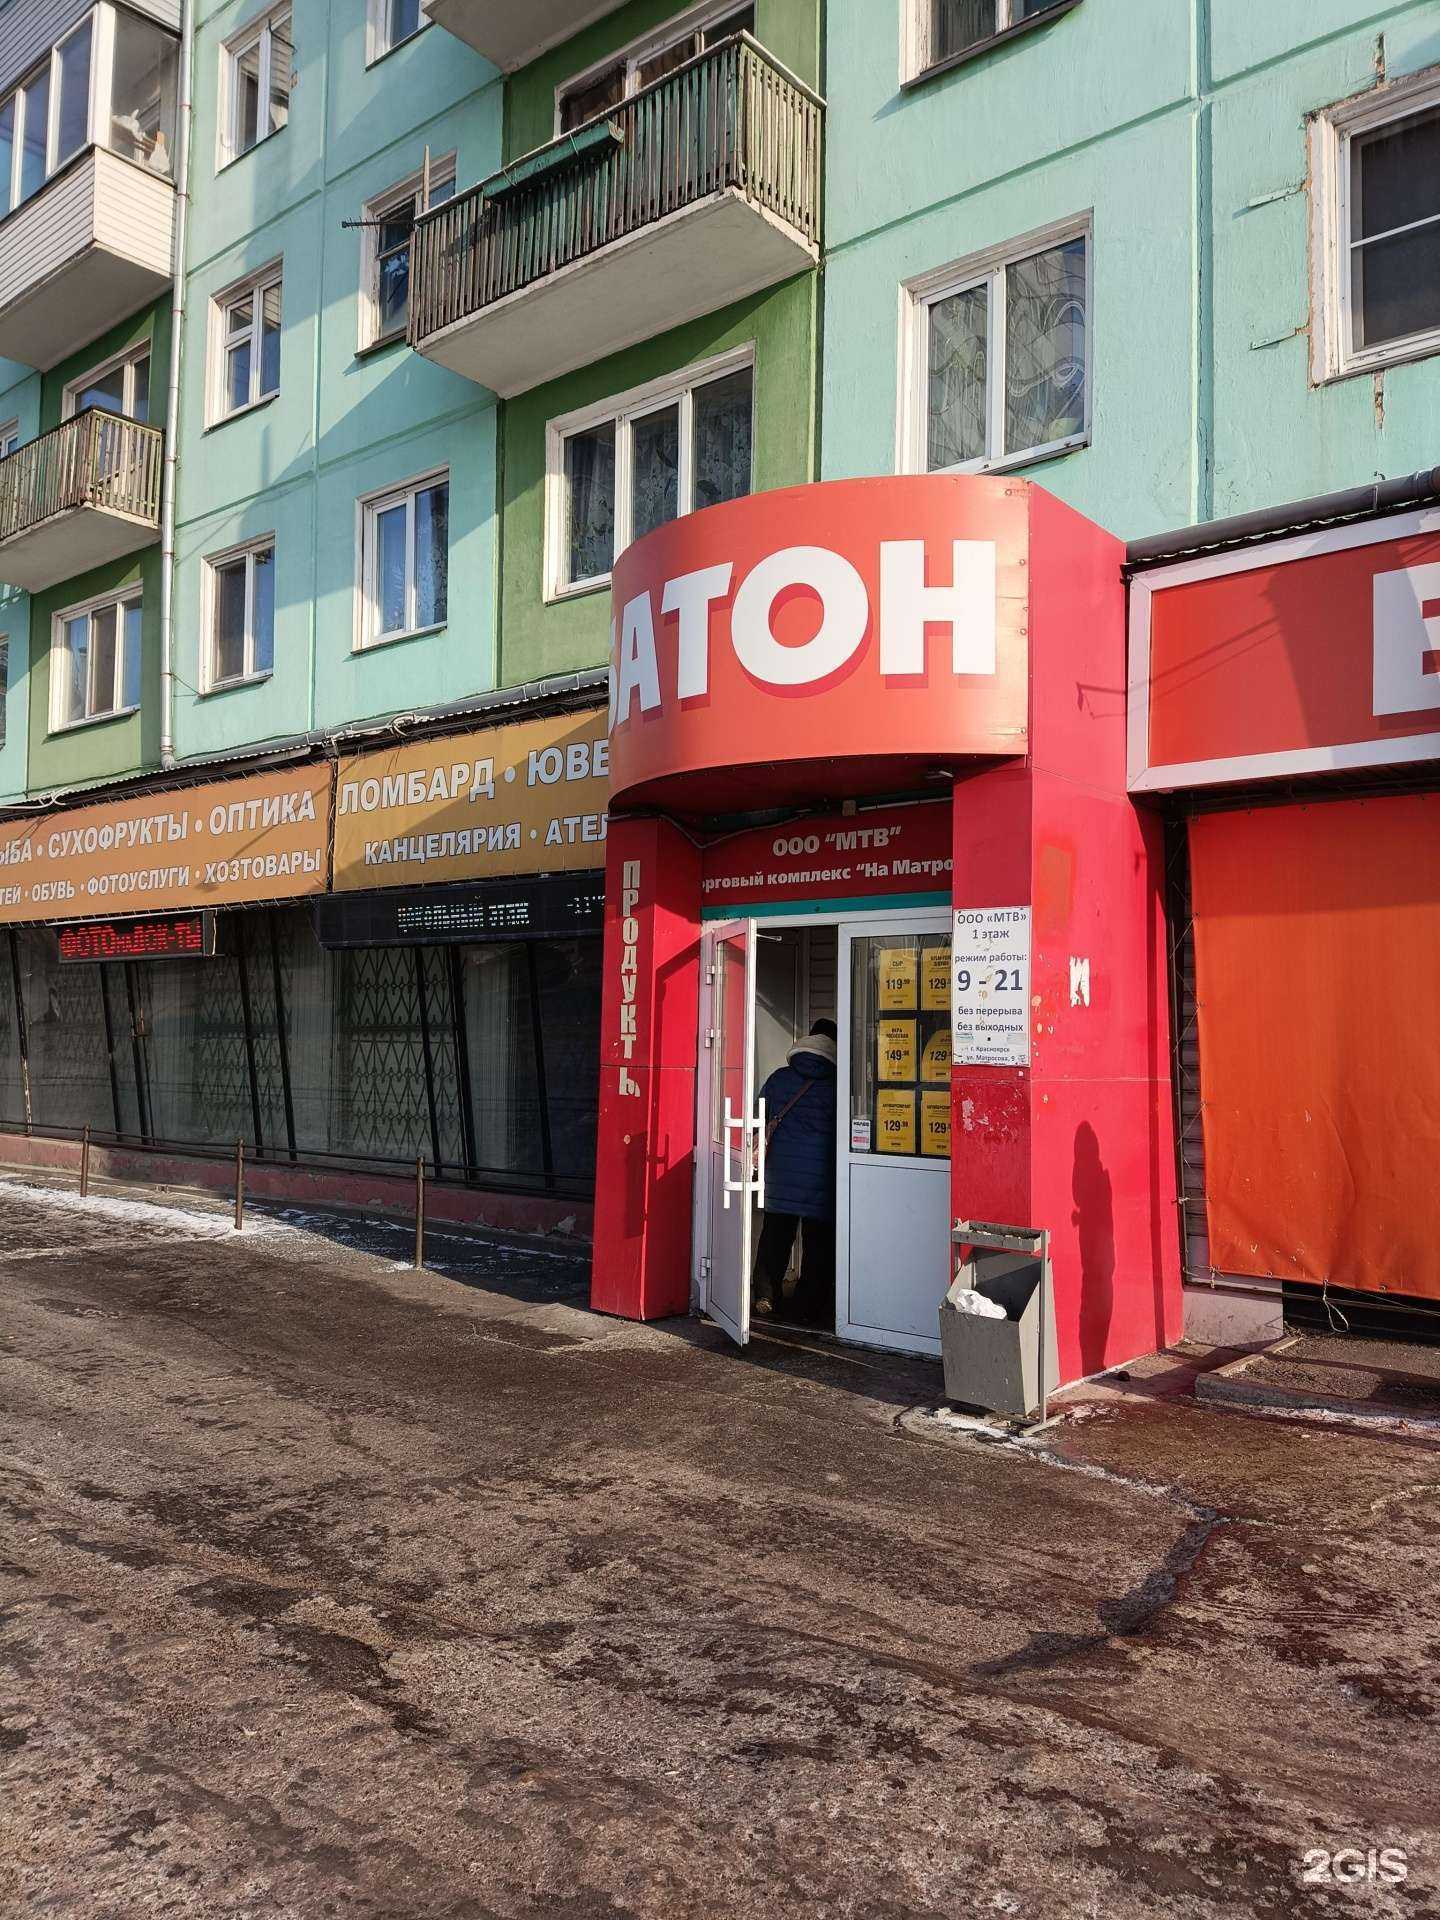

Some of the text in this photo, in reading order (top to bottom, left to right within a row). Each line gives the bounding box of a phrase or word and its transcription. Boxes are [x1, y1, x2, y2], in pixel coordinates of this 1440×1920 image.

[608, 540, 996, 734] АТОН
[338, 757, 495, 816] ЛОМБАРД
[47, 811, 188, 858] СУХОФРУКТЫ
[208, 790, 316, 836] ОПТИКА
[364, 822, 522, 865] КАНЦЕЛЯРИЯ
[31, 879, 75, 902] ОБУВЬ
[86, 865, 190, 896] ФОТОУСЛУГИ
[203, 848, 321, 884] ХОЗТОВАРЫ
[702, 871, 764, 893] рговый
[767, 867, 851, 885] комплекс
[972, 929, 1010, 940] 1 этаж
[954, 954, 987, 964] режим
[989, 953, 1027, 962] работы:
[957, 970, 971, 992] 9
[995, 969, 1023, 991] 21
[958, 1006, 1023, 1017] без перерыва
[957, 1022, 1024, 1034] без выходных
